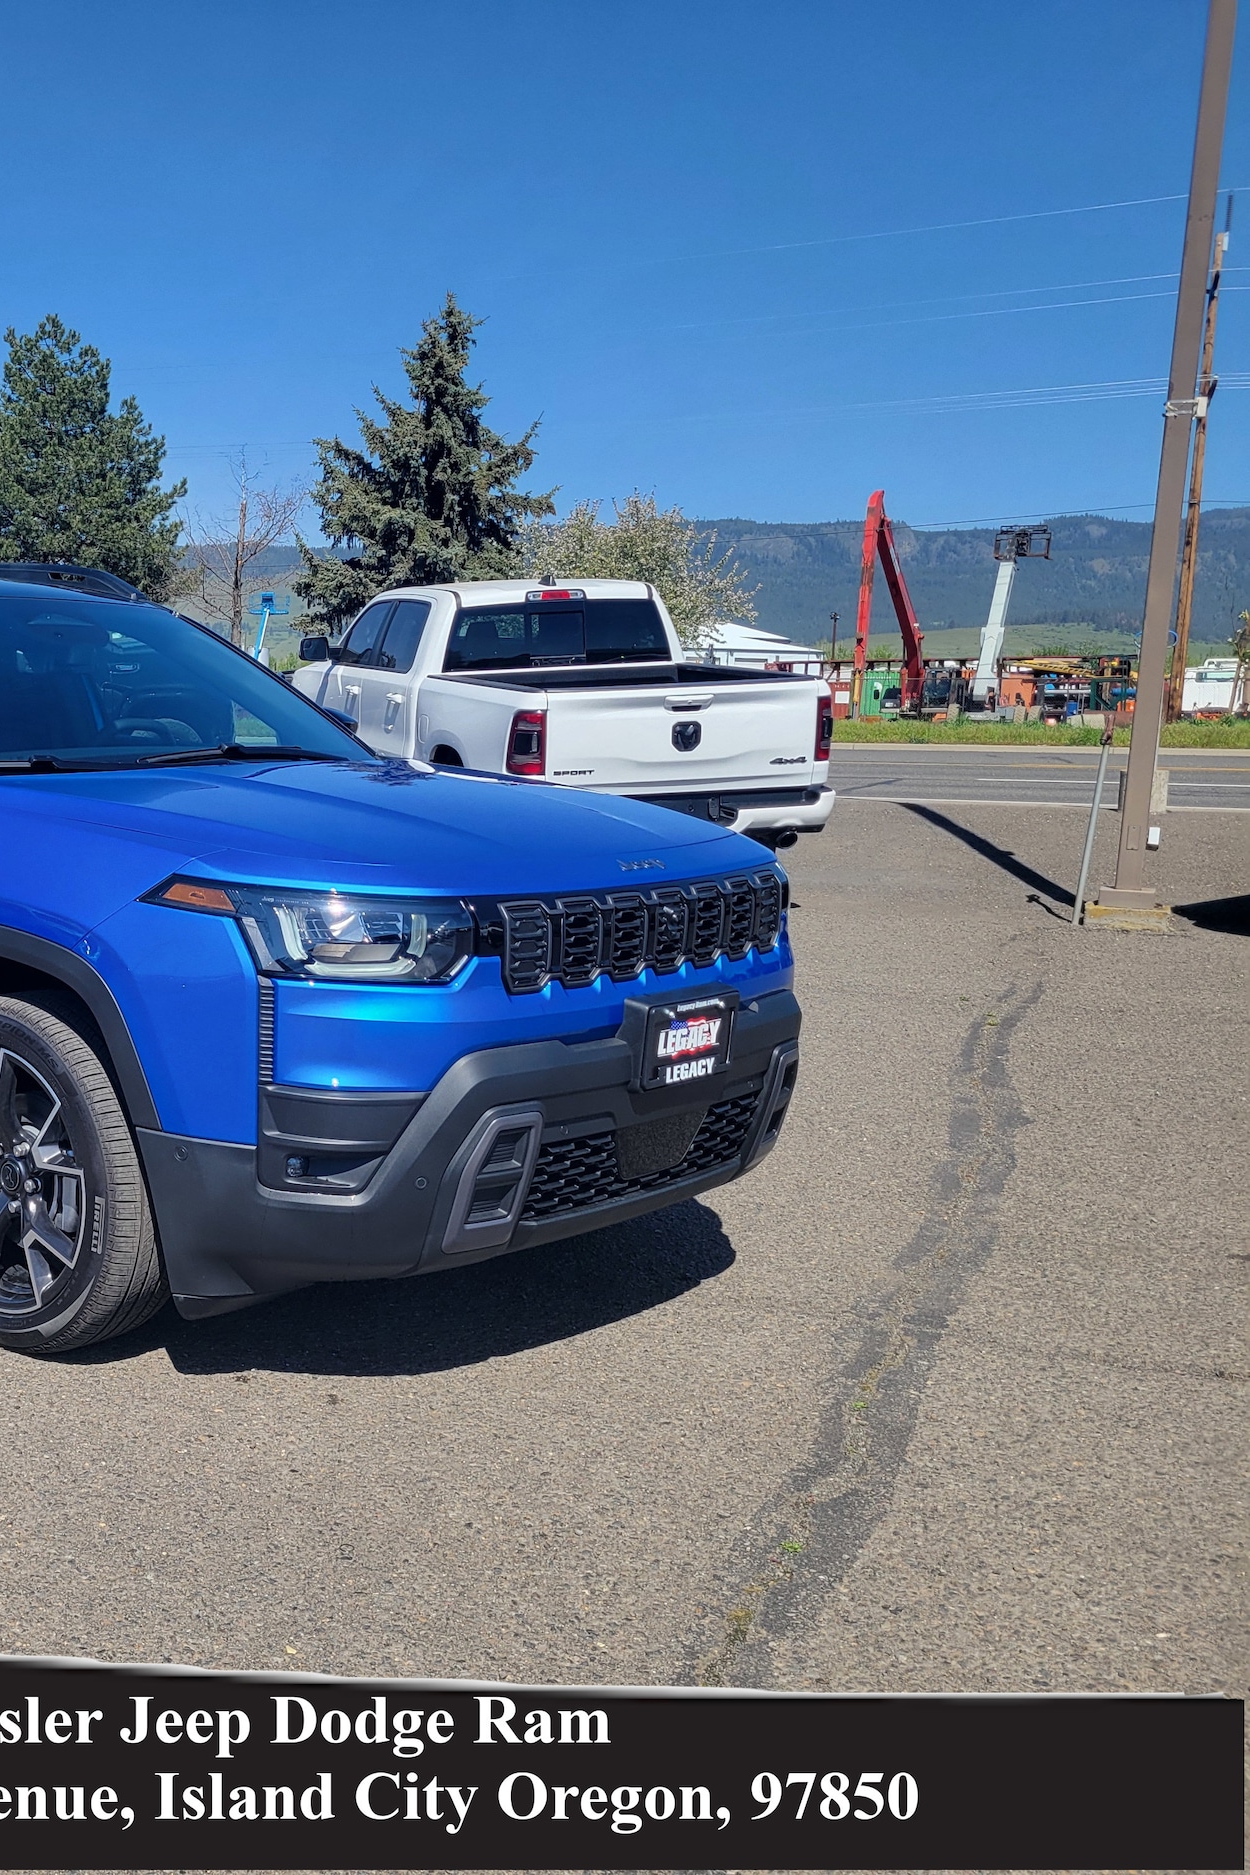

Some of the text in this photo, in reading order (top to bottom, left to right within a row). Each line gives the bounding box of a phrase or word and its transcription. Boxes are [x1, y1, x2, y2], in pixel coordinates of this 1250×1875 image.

[658, 1021, 720, 1055] LEGACY
[665, 1057, 715, 1084] LEGACY
[91, 1196, 105, 1254] PIRELLI
